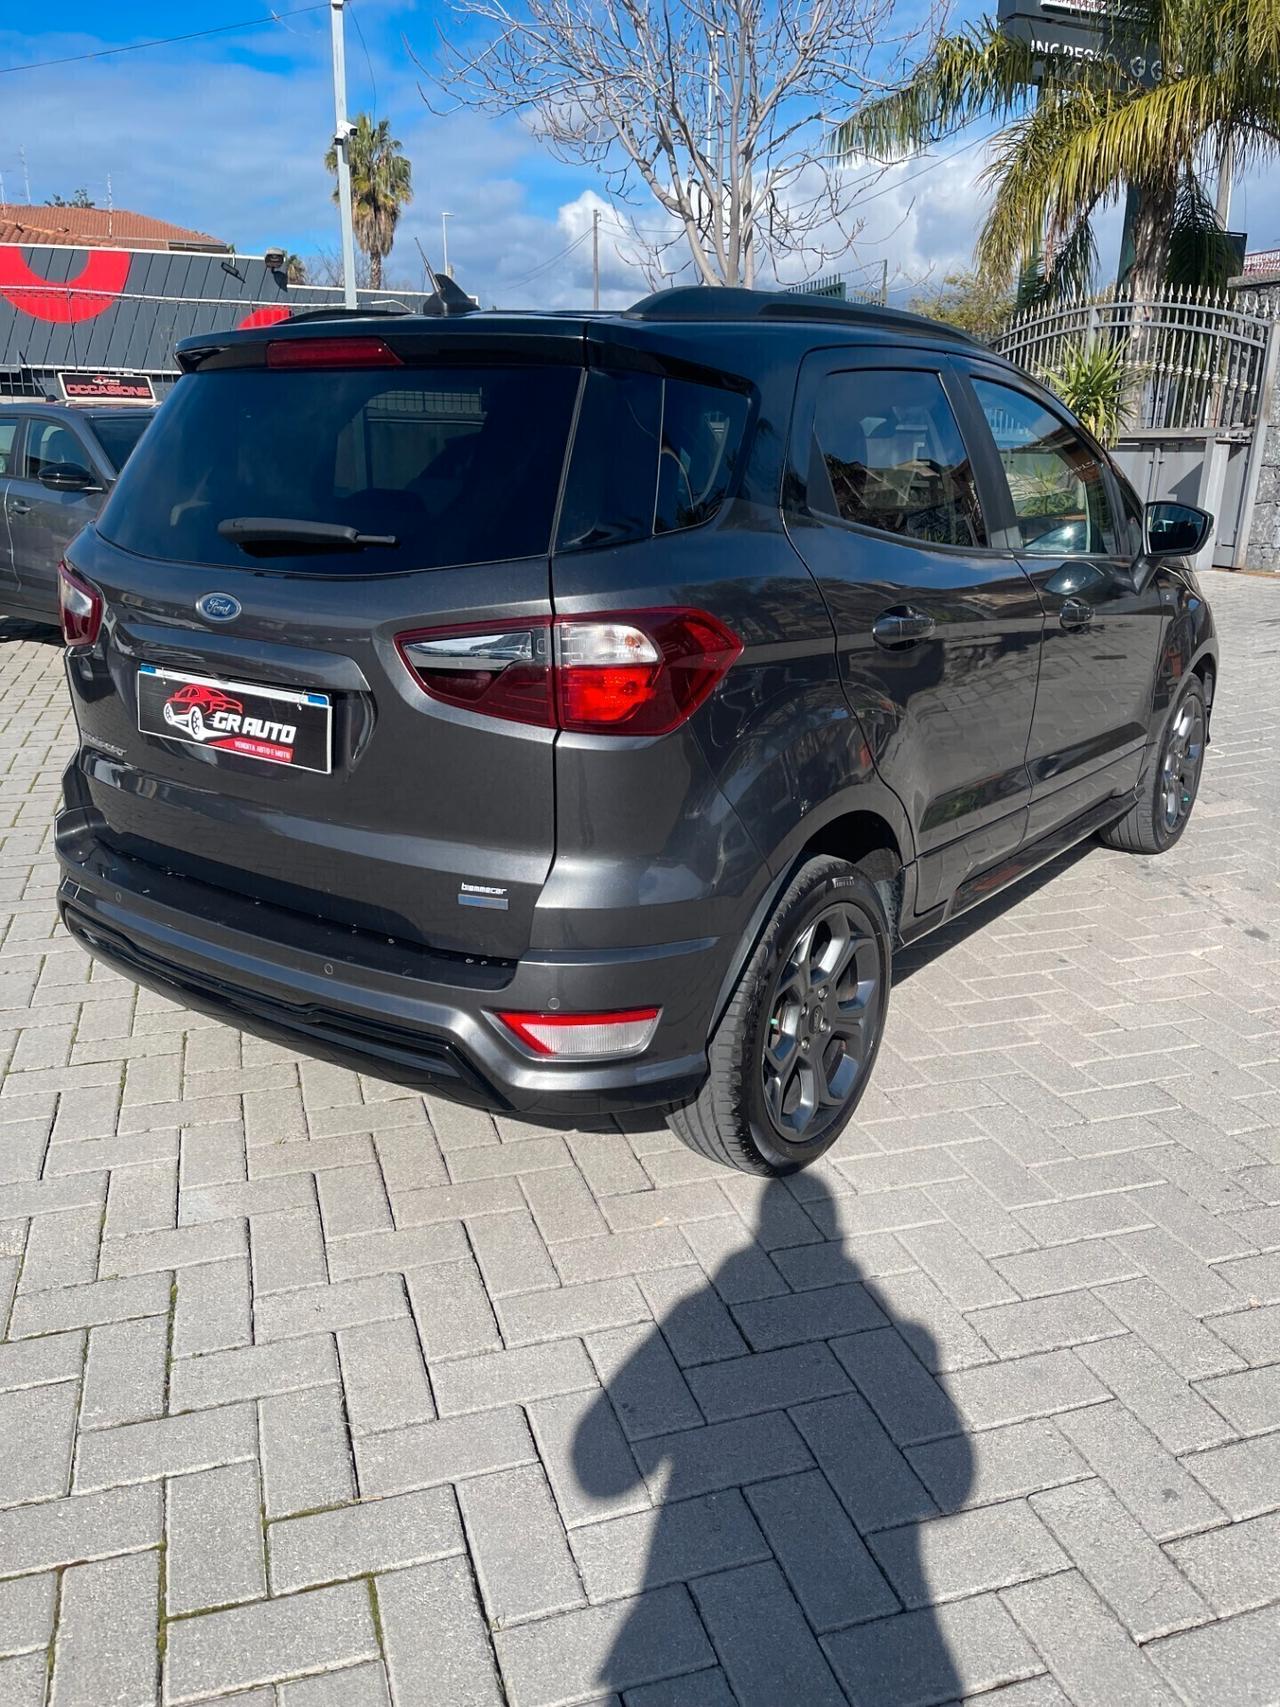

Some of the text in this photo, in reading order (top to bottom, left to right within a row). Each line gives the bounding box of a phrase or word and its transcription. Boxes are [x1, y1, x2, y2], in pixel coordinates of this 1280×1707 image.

[66, 384, 151, 396] OCCASIONE
[207, 598, 231, 615] Ford
[212, 711, 297, 744] GR AUTO
